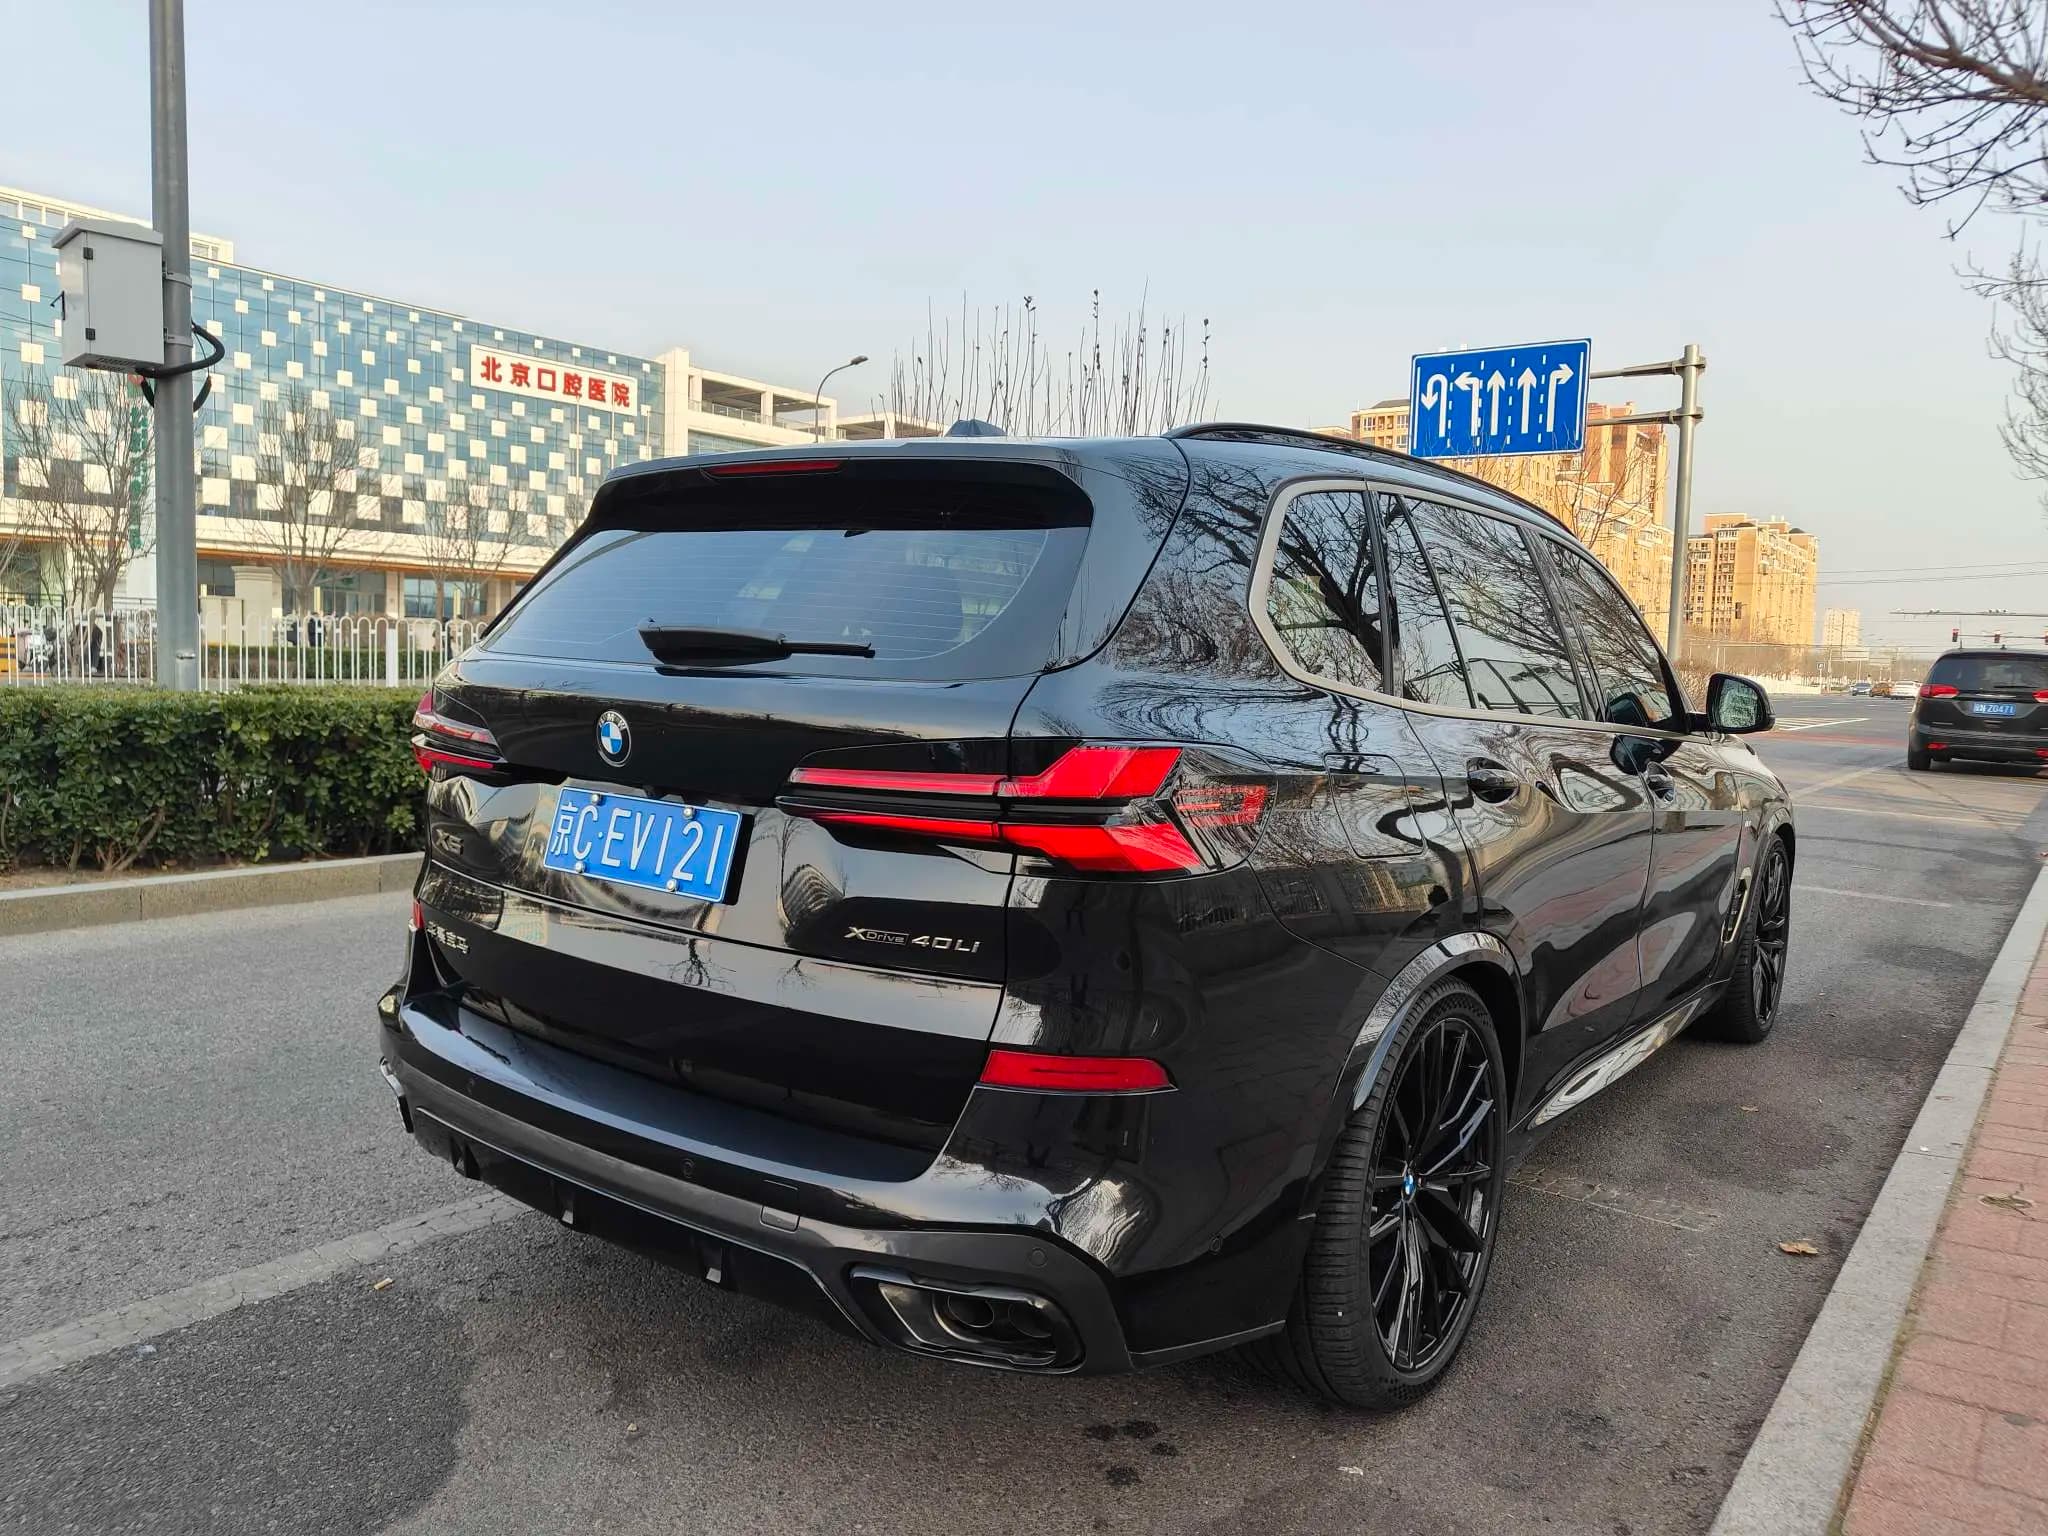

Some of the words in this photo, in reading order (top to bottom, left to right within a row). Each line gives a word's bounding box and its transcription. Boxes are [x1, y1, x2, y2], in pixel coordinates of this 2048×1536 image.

[480, 355, 631, 408] 北京口腔医院
[597, 712, 628, 732] BMW
